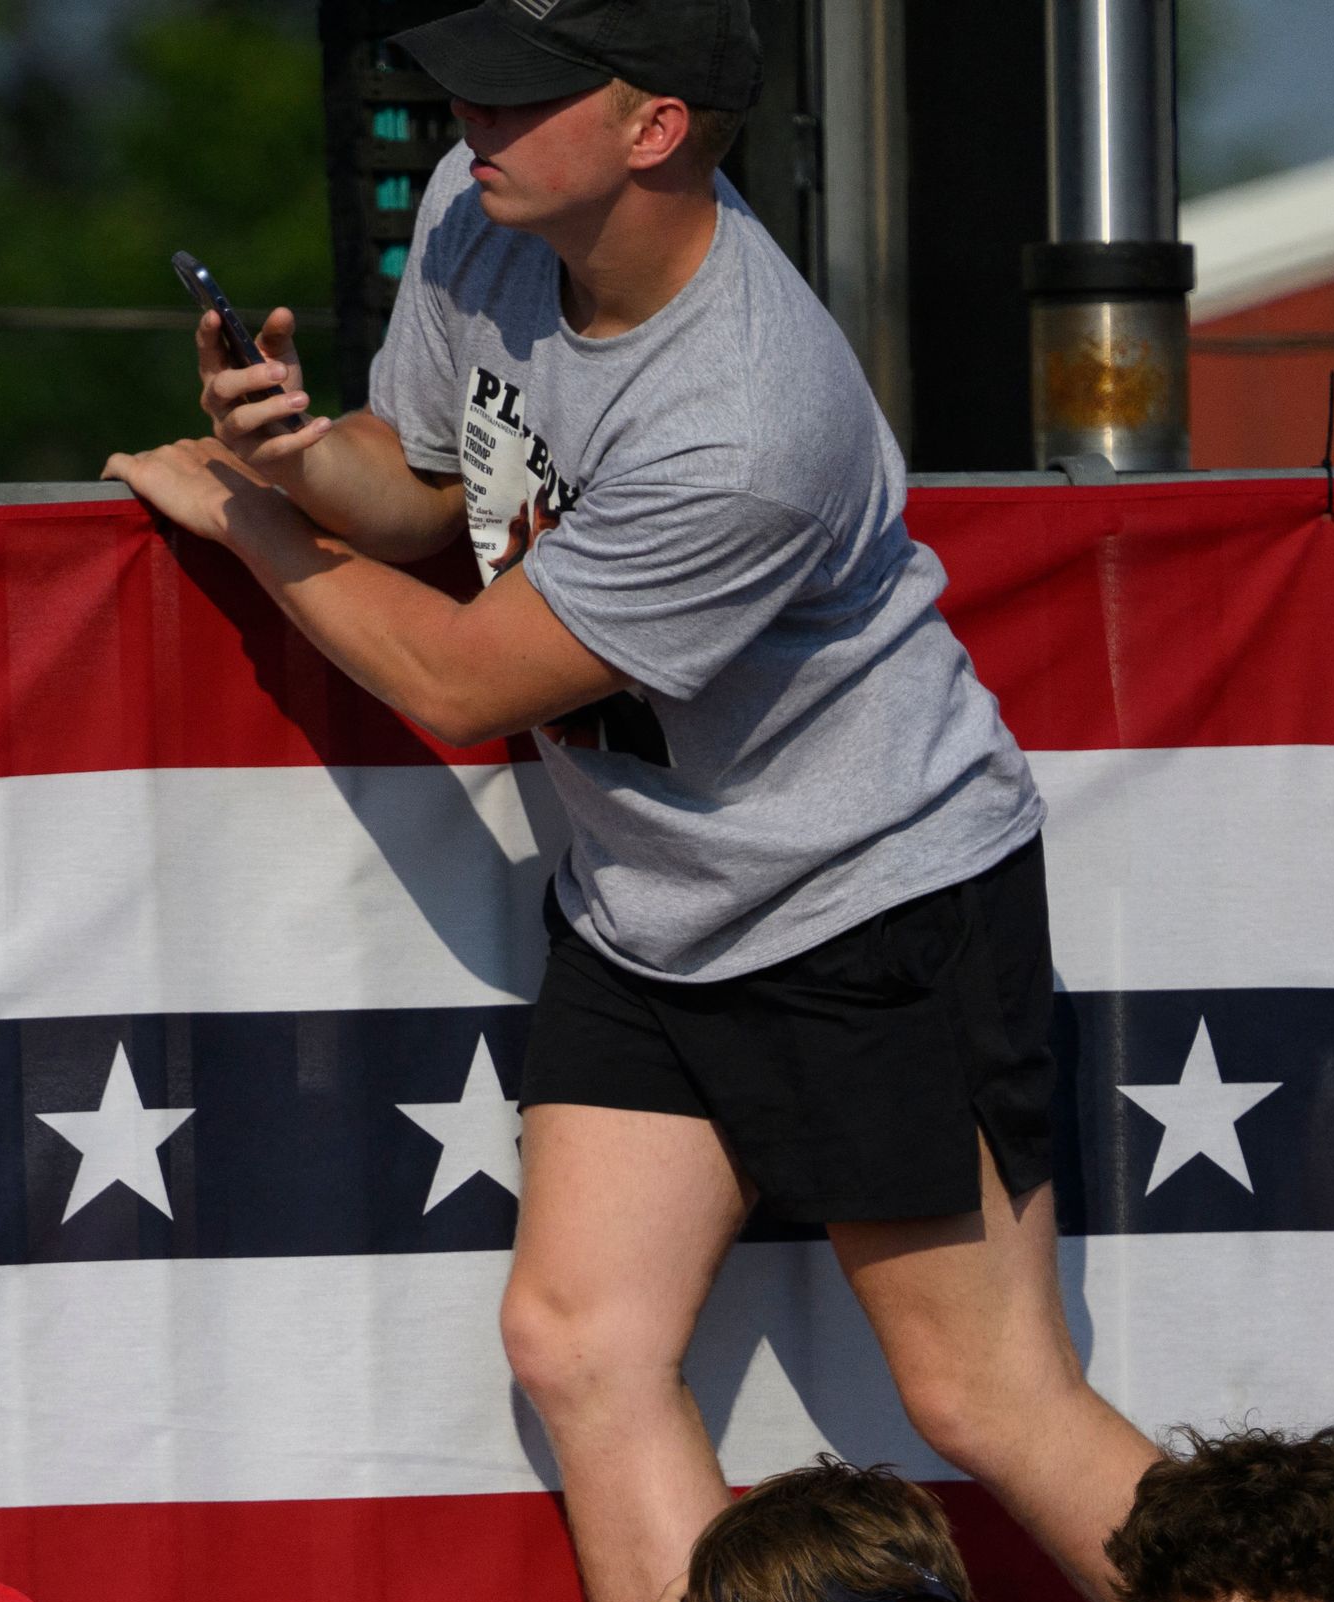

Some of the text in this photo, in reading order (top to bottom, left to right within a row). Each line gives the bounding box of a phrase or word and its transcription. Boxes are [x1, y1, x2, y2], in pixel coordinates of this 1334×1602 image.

[465, 434, 491, 461] TRUMP
[467, 421, 496, 450] DONALD
[462, 449, 494, 477] INTERVIEW
